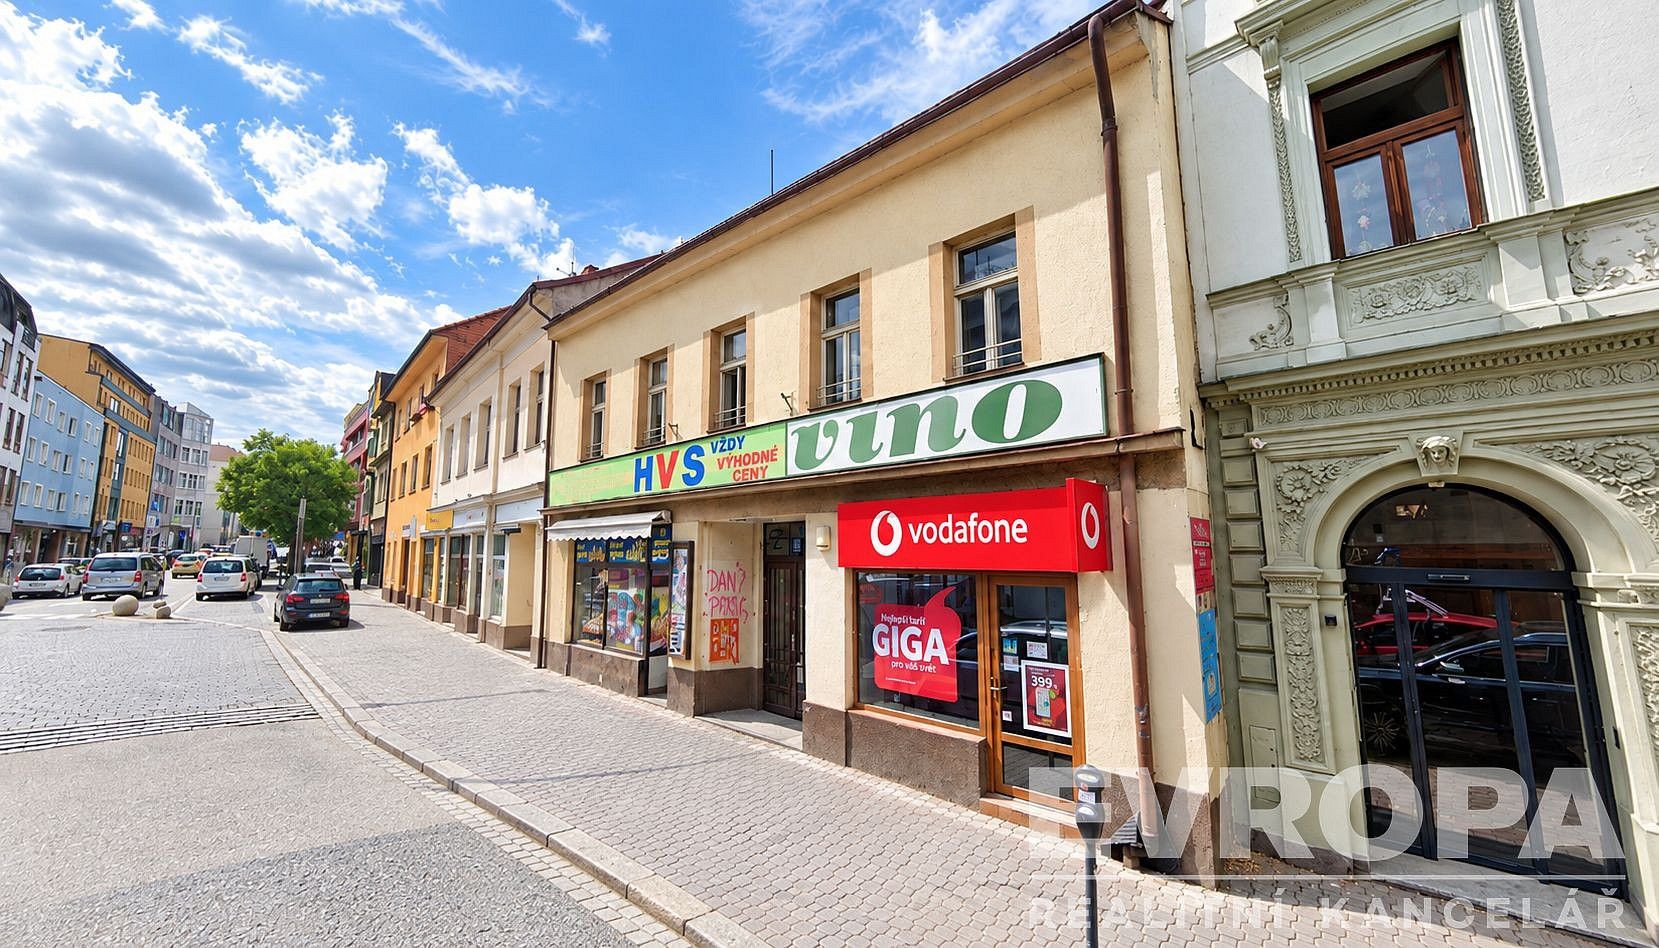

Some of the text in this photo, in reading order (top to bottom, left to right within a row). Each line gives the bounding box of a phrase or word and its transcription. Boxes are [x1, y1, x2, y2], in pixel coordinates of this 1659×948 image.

[791, 379, 1062, 470] vino
[710, 435, 745, 454] VŽDY
[716, 445, 779, 471] VÝHODNÉ
[633, 445, 705, 493] HVS
[732, 465, 769, 482] CENY
[908, 512, 1028, 544] vodafone
[872, 623, 950, 665] GIGA
[1031, 675, 1053, 689] 399
